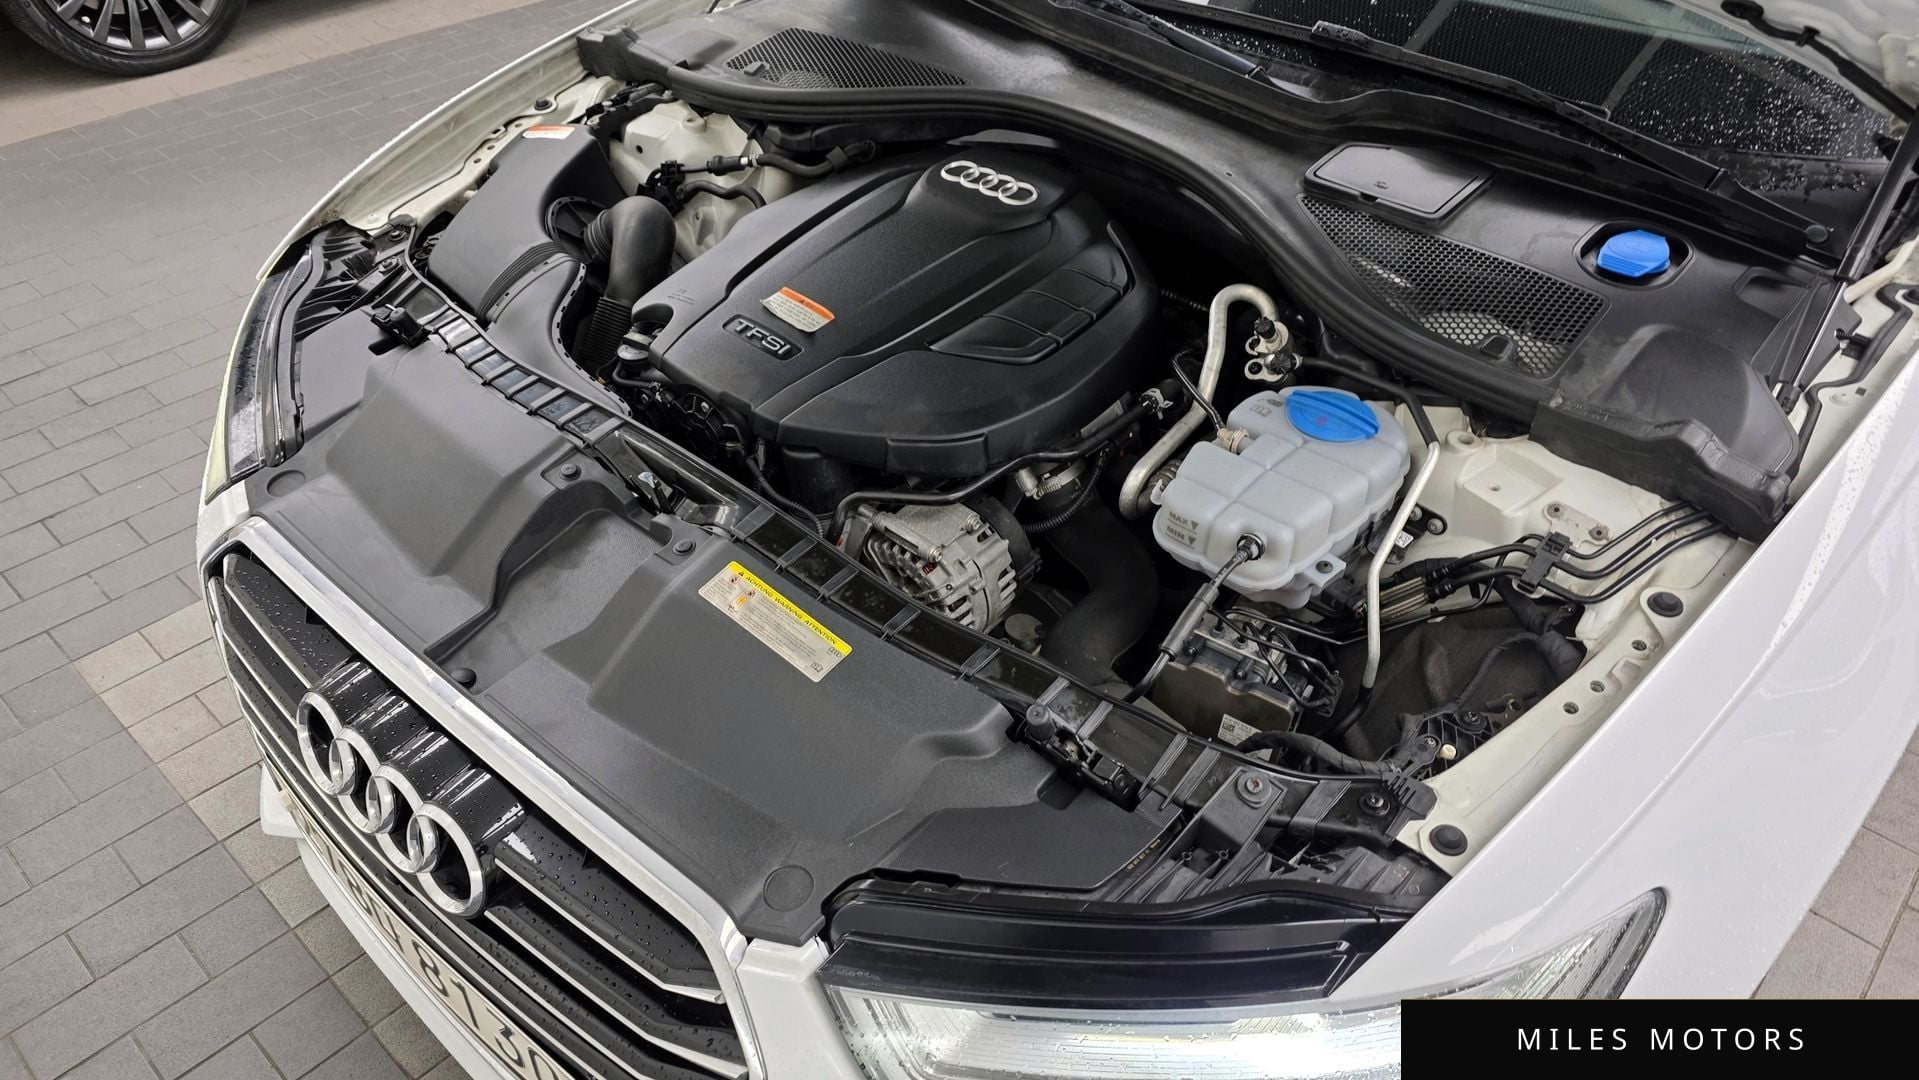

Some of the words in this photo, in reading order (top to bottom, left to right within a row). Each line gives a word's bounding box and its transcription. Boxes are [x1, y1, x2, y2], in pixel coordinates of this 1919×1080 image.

[735, 319, 791, 354] TFSI
[1169, 511, 1188, 527] MAX
[1166, 525, 1185, 540] MIN
[745, 576, 773, 598] ACHTUNG
[774, 596, 803, 619] WARNING
[804, 618, 838, 645] ATTENTION
